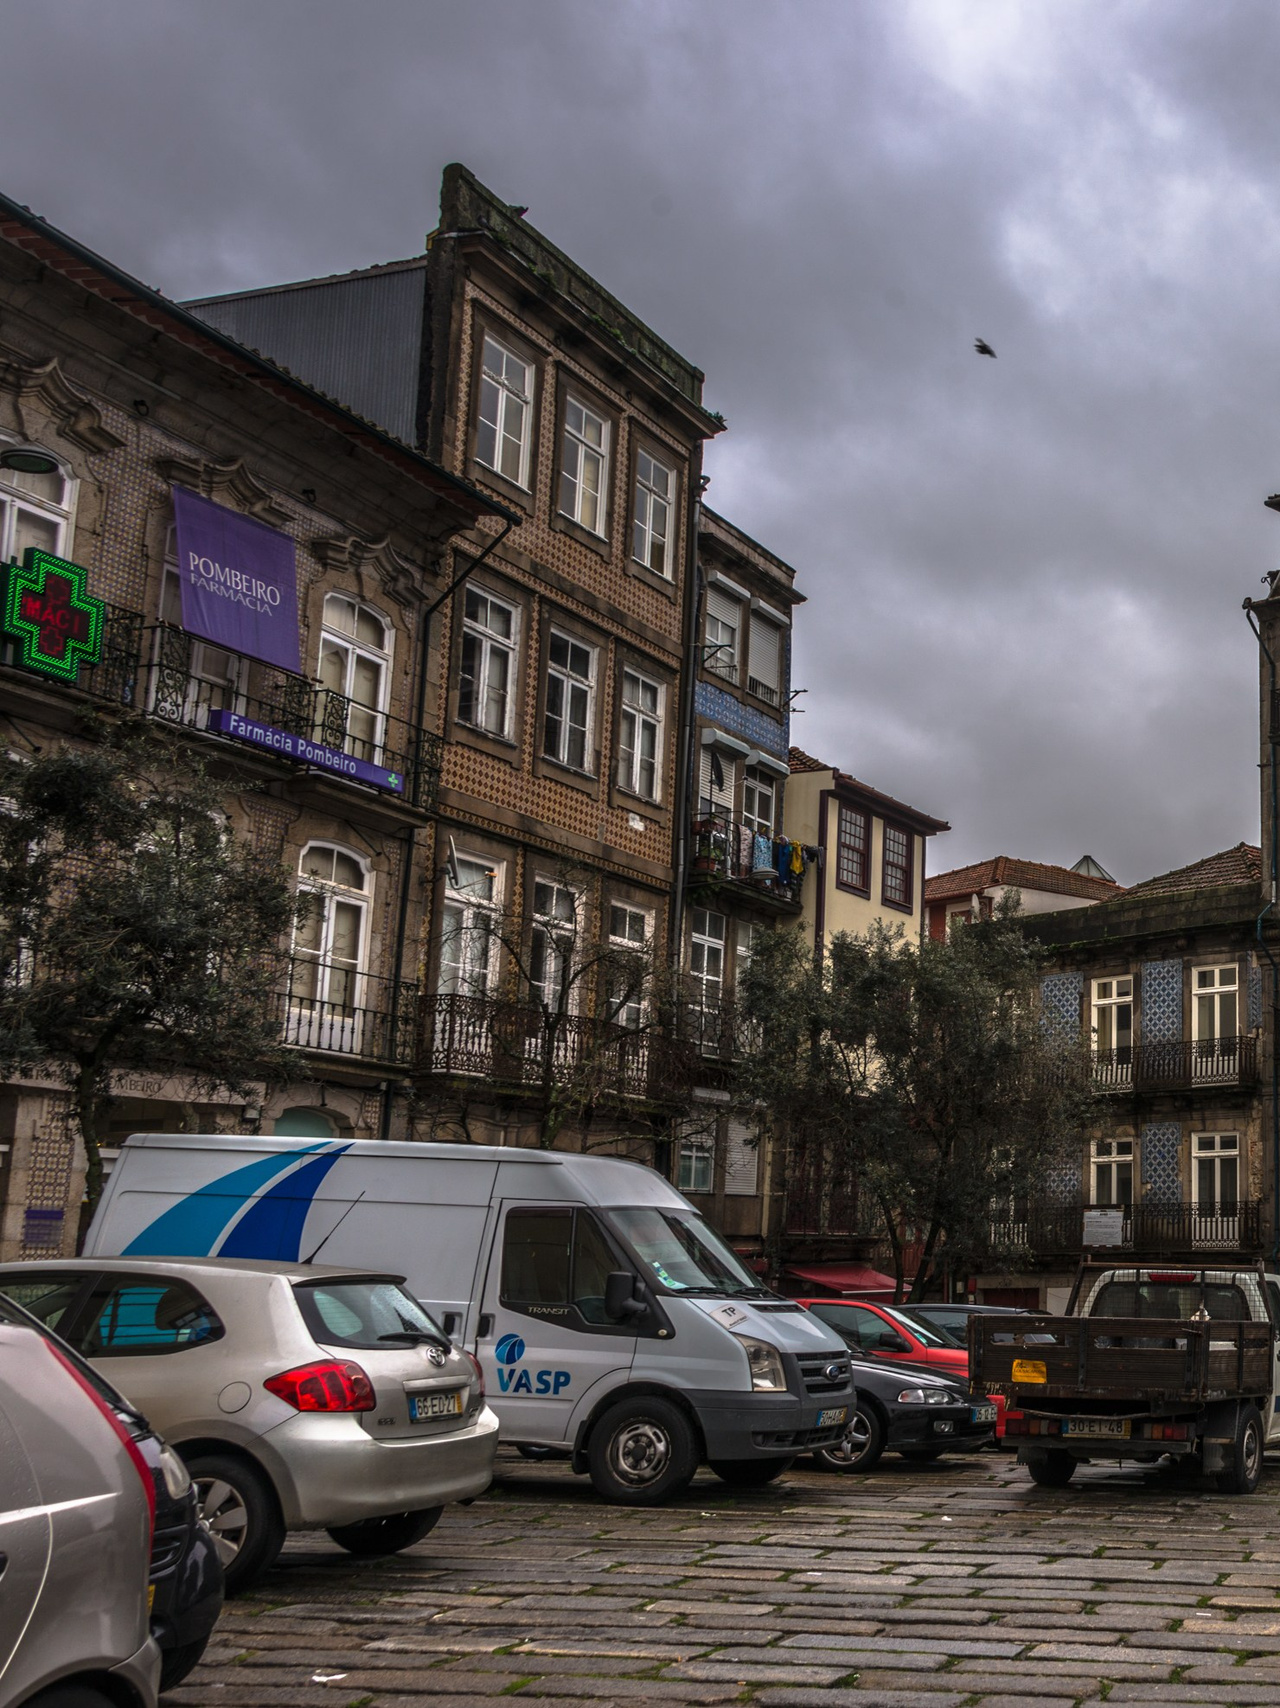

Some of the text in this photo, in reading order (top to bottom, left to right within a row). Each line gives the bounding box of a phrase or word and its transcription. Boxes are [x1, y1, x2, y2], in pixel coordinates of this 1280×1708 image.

[189, 551, 280, 606] POMBEIRO
[190, 573, 273, 616] FARMÁCIA
[229, 714, 357, 774] Farmácia Pombeiro
[107, 1076, 161, 1094] OMBEIRO
[528, 1306, 570, 1315] TRANSIT
[721, 1306, 737, 1317] TP
[497, 1367, 571, 1395] VASP
